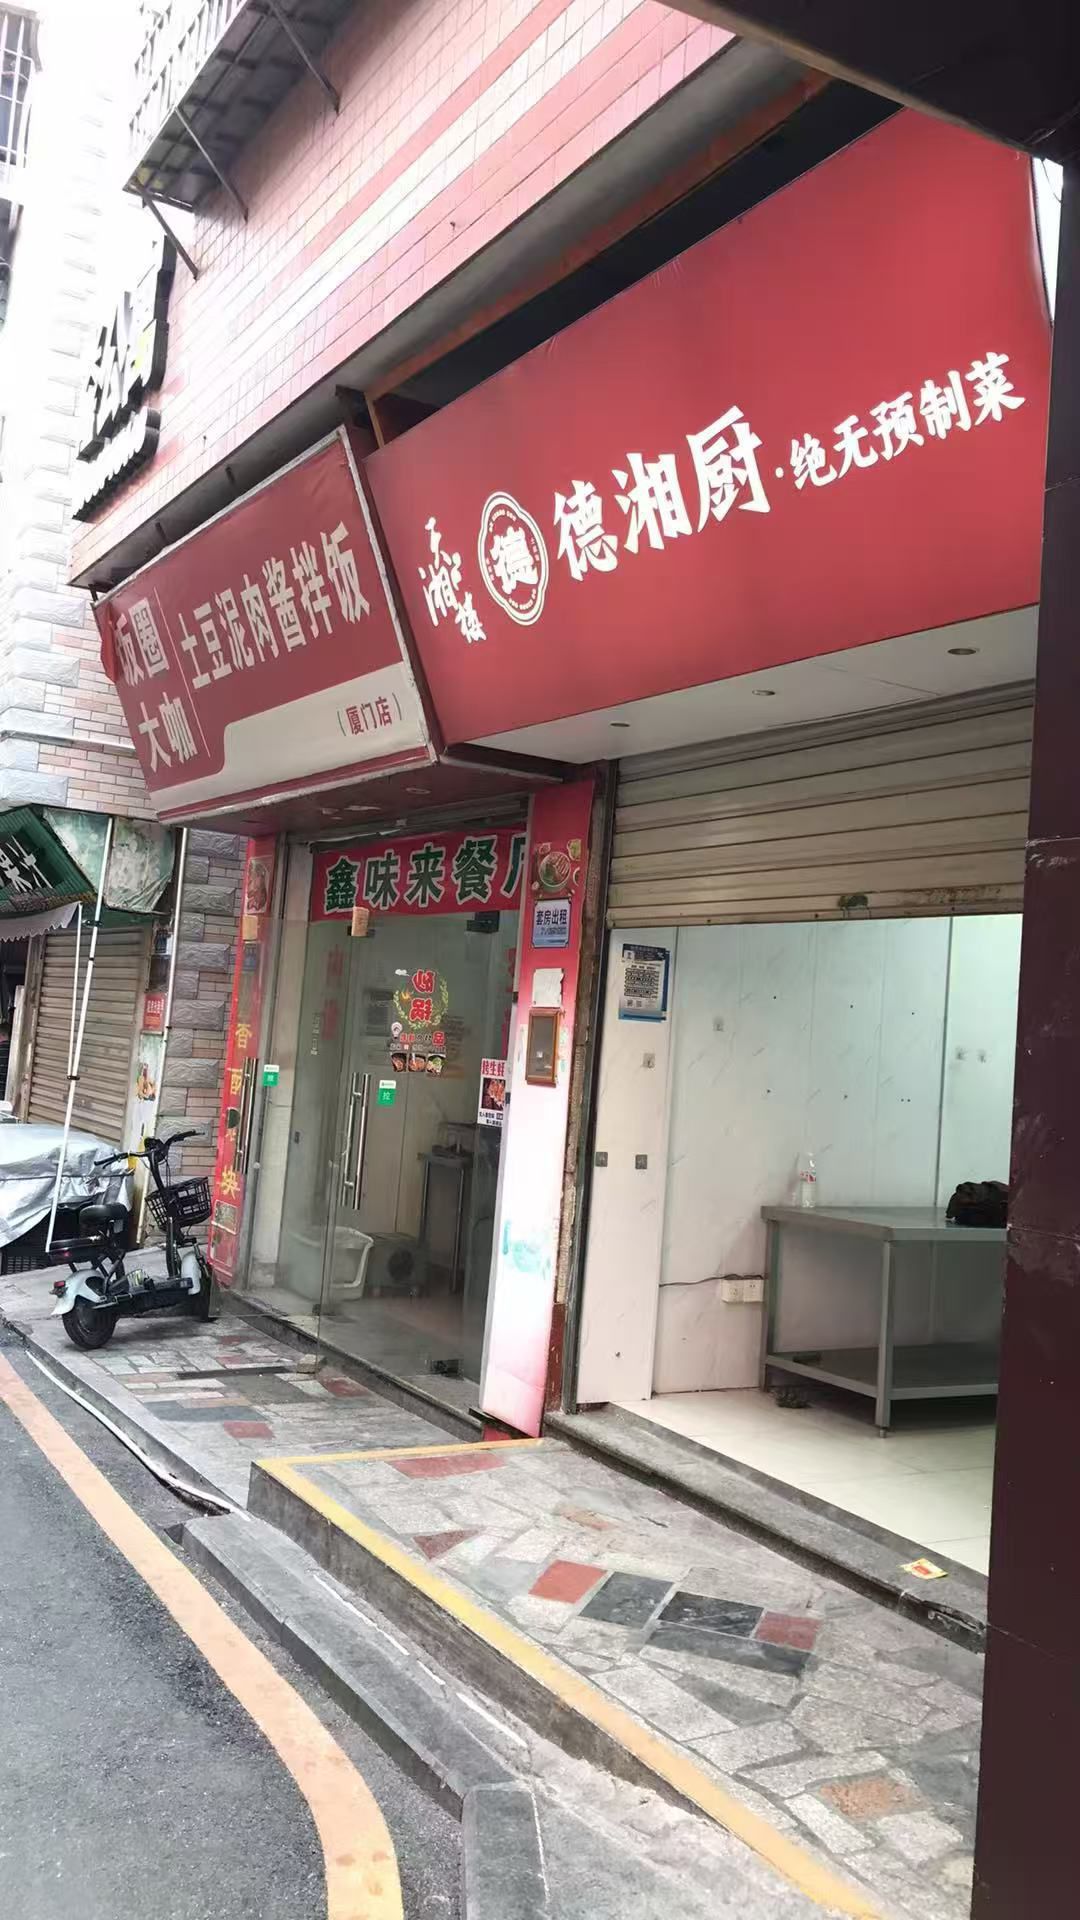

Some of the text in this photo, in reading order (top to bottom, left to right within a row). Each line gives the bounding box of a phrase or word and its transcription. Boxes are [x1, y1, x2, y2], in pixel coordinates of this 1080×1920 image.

[553, 405, 771, 581] 德湘厨
[179, 521, 370, 689] 土豆泥肉酱拌饭
[138, 692, 198, 773] 大咖
[536, 909, 567, 926] 套房出租
